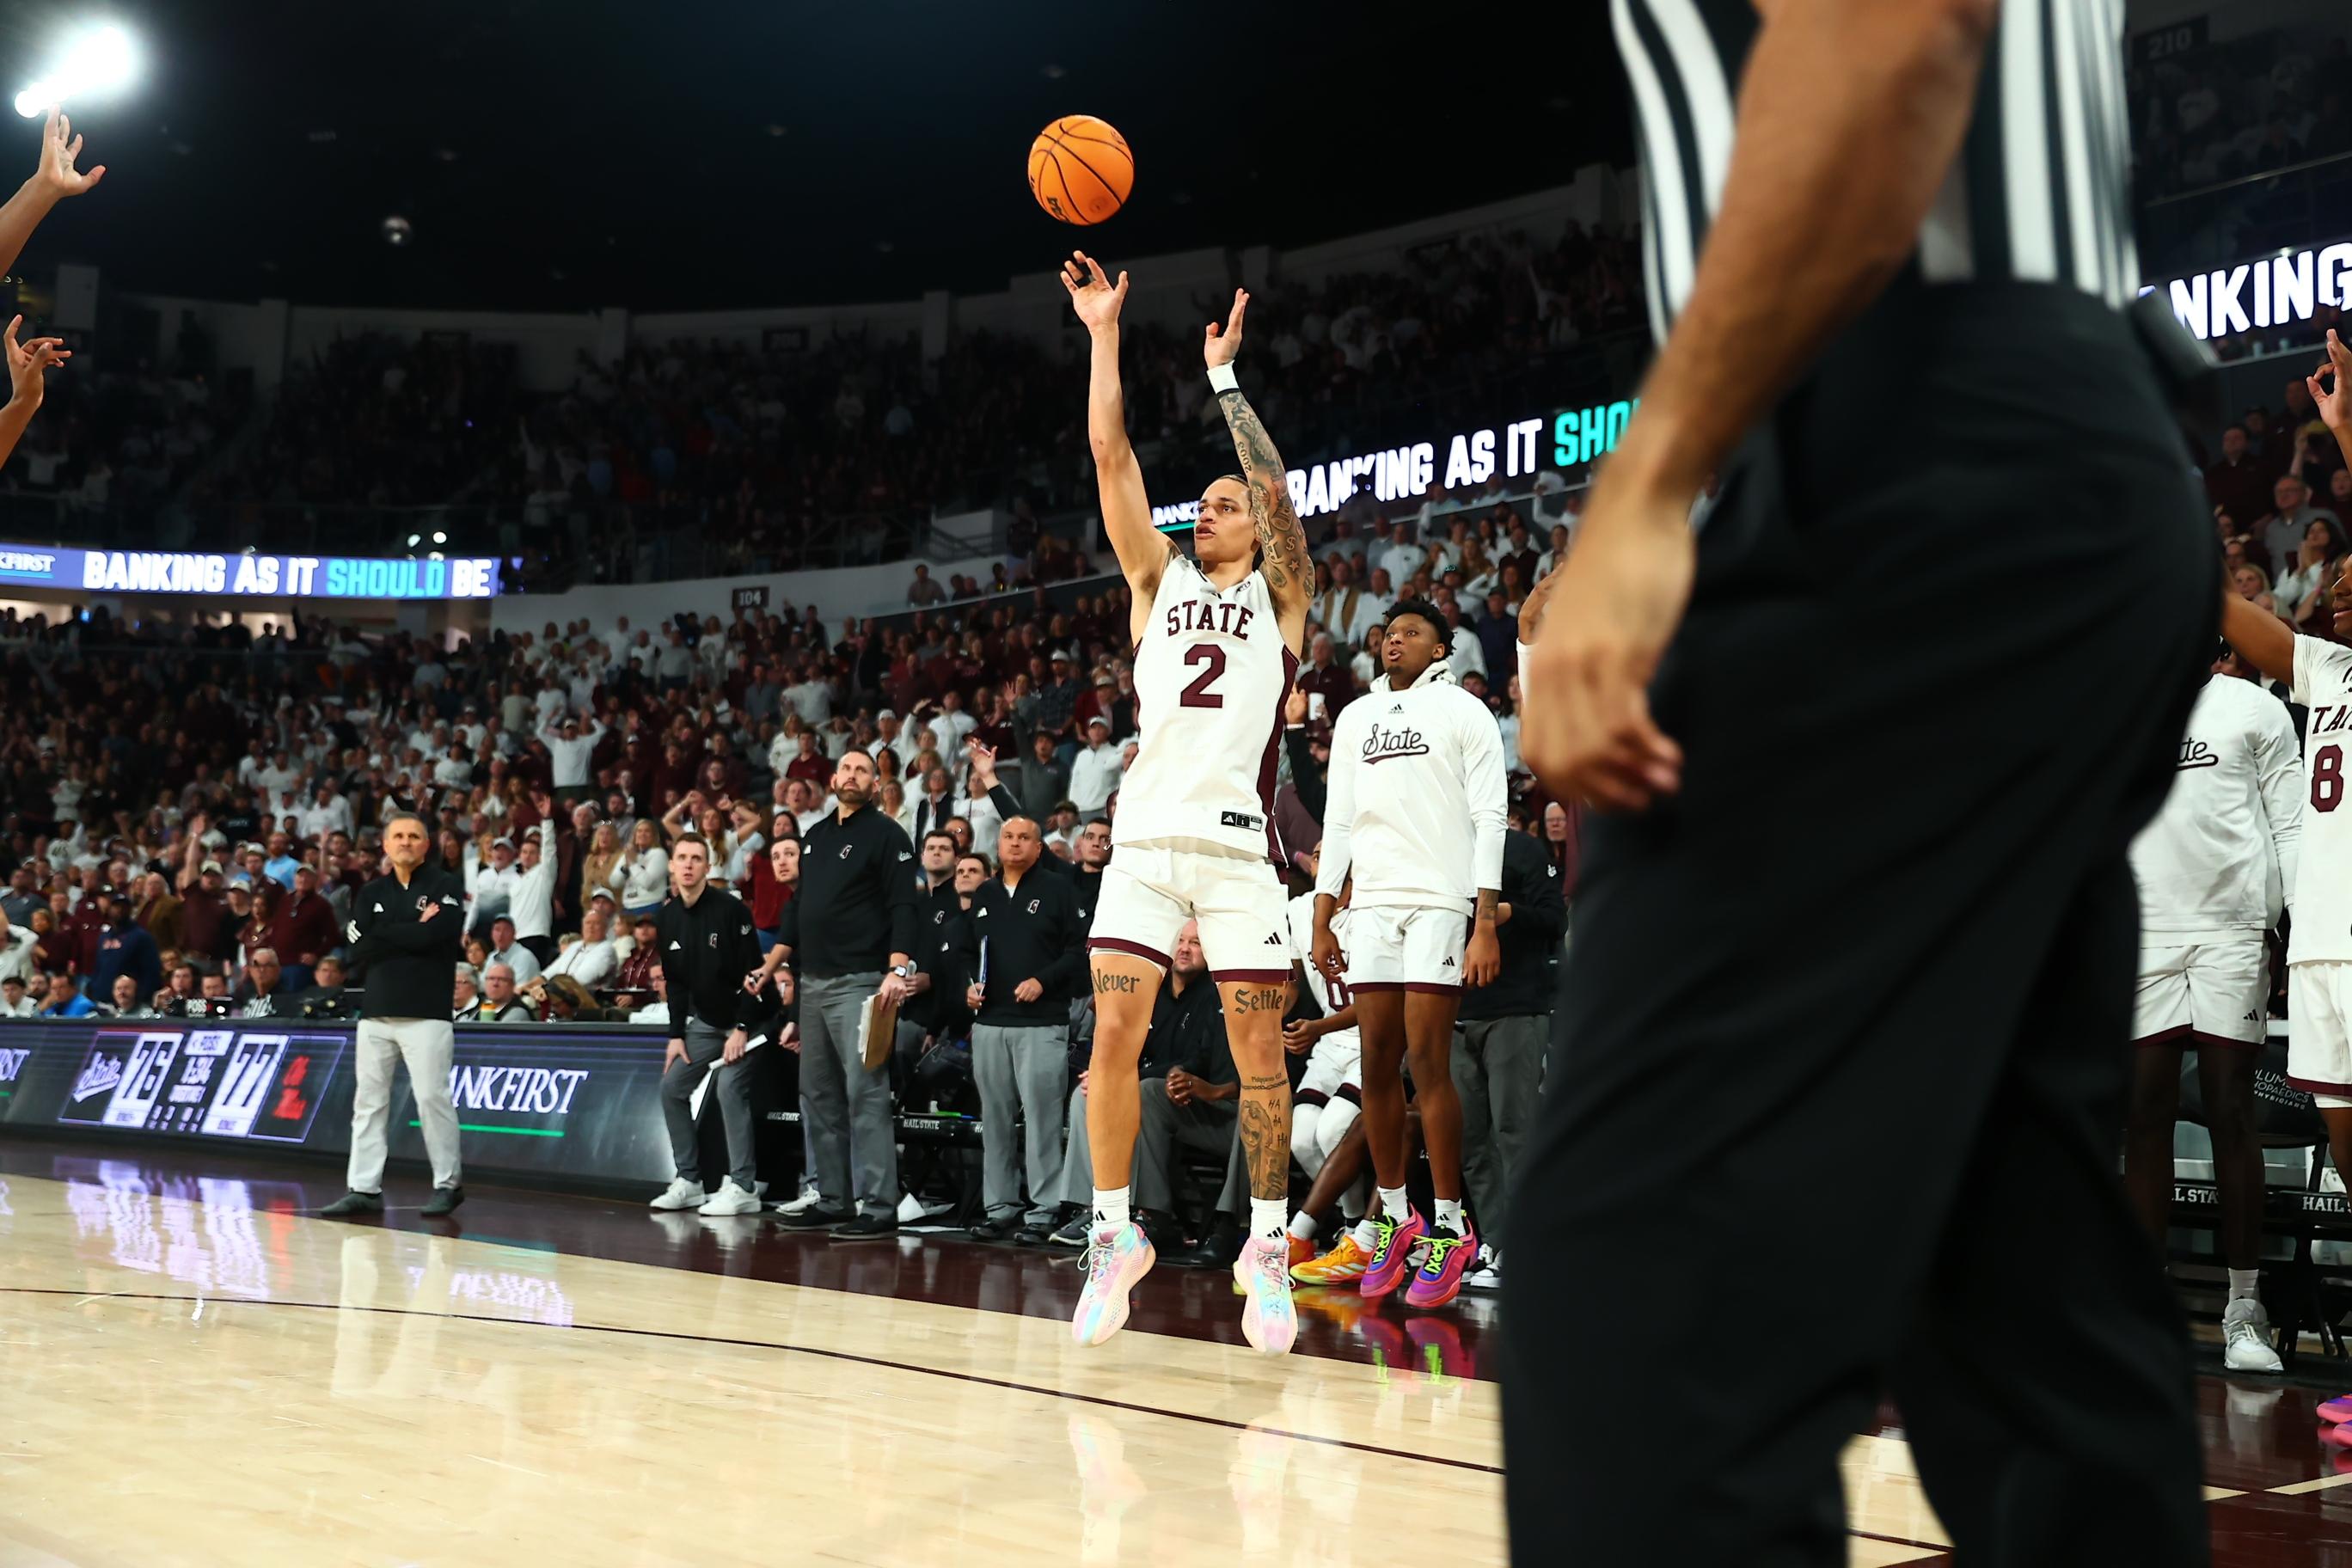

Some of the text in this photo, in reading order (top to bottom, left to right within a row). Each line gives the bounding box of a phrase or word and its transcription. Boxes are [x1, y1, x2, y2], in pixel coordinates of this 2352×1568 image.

[2148, 28, 2192, 61] 210
[2139, 242, 2352, 340] NKING
[1444, 429, 1496, 490] AS
[1507, 418, 1543, 477] IT
[1554, 397, 1641, 467] SHO
[83, 550, 493, 597] BANKING AS IT SHOULD BE
[739, 591, 762, 606] 104
[1167, 599, 1254, 640] STATE
[1179, 643, 1227, 708] 2
[1361, 723, 1430, 765] State
[2310, 744, 2344, 813] 8
[1092, 968, 1141, 995] Never
[1234, 989, 1284, 1014] Settle
[222, 1042, 279, 1108] 77
[2255, 1069, 2291, 1089] LUM
[903, 1119, 940, 1130] HAIL STATE
[2302, 1196, 2345, 1213] HAIL
